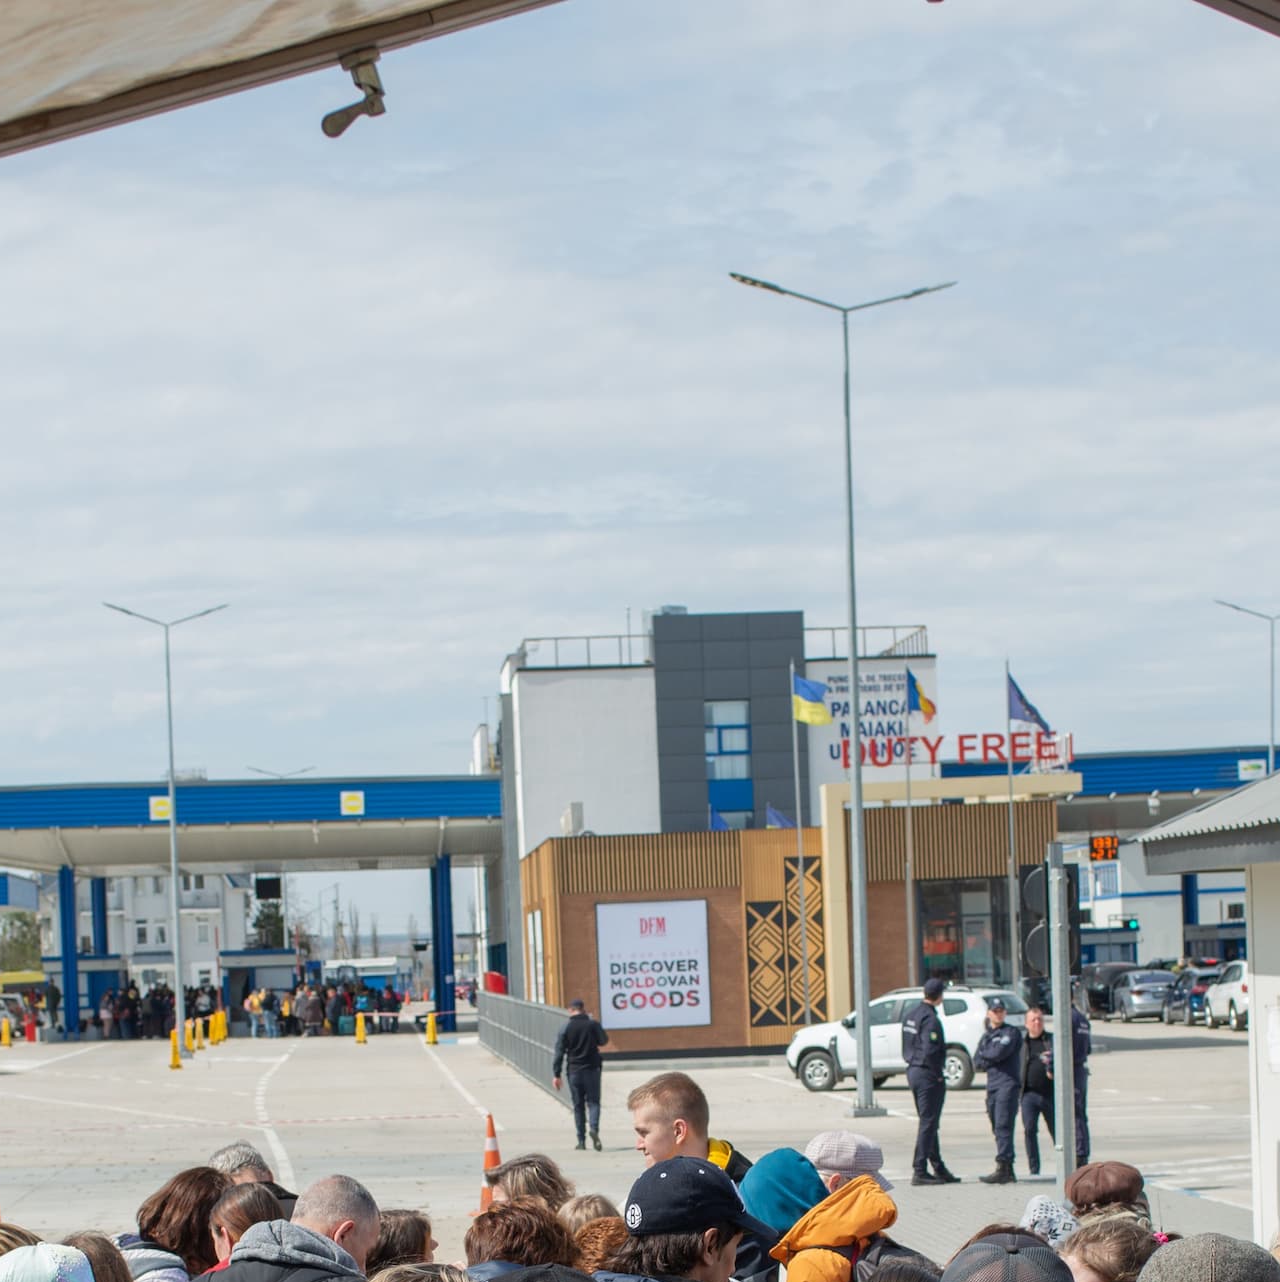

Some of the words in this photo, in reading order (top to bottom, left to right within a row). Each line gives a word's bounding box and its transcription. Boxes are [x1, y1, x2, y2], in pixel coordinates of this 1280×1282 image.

[831, 699, 911, 717] PAANCA
[842, 736, 944, 769] DUTY
[958, 731, 1059, 765] FREE
[610, 959, 699, 975] DISCOVER
[611, 975, 700, 989] MOLDOVAN
[612, 990, 700, 1010] GOODS
